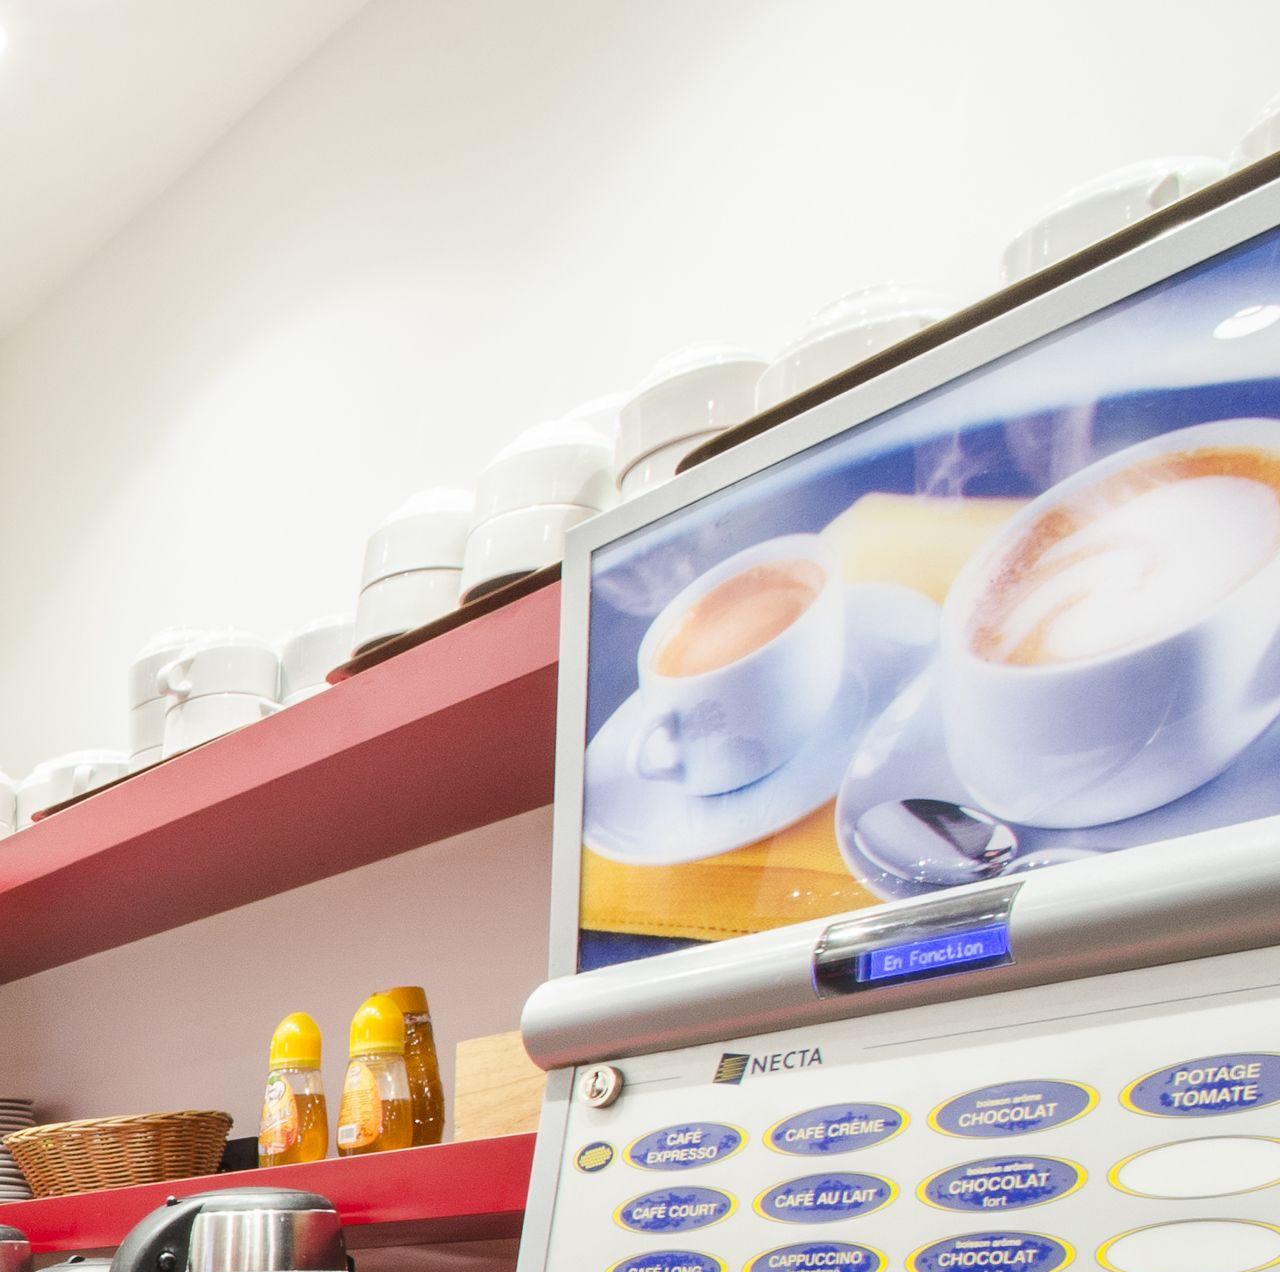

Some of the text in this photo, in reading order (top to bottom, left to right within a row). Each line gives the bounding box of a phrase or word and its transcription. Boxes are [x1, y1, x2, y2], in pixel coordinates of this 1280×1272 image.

[884, 940, 984, 972] En Fonction
[750, 1047, 823, 1074] NECTA
[1174, 1062, 1262, 1086] POTAGE
[1171, 1084, 1259, 1107] TOMATE
[958, 1103, 1058, 1127] CHOCOLAT
[666, 1129, 703, 1146] CAFÉ
[784, 1122, 824, 1142] CAFÉ
[646, 1146, 718, 1164] EXPRESSO
[948, 1173, 1050, 1195] CHOCOLAT
[774, 1189, 877, 1208] CAFÉ AU LAIT
[982, 1195, 1007, 1208] fort
[632, 1203, 718, 1220] CAFÉ COURT
[768, 1251, 863, 1268] CAPPUCCINO
[938, 1249, 1038, 1267] CHOCOLAT
